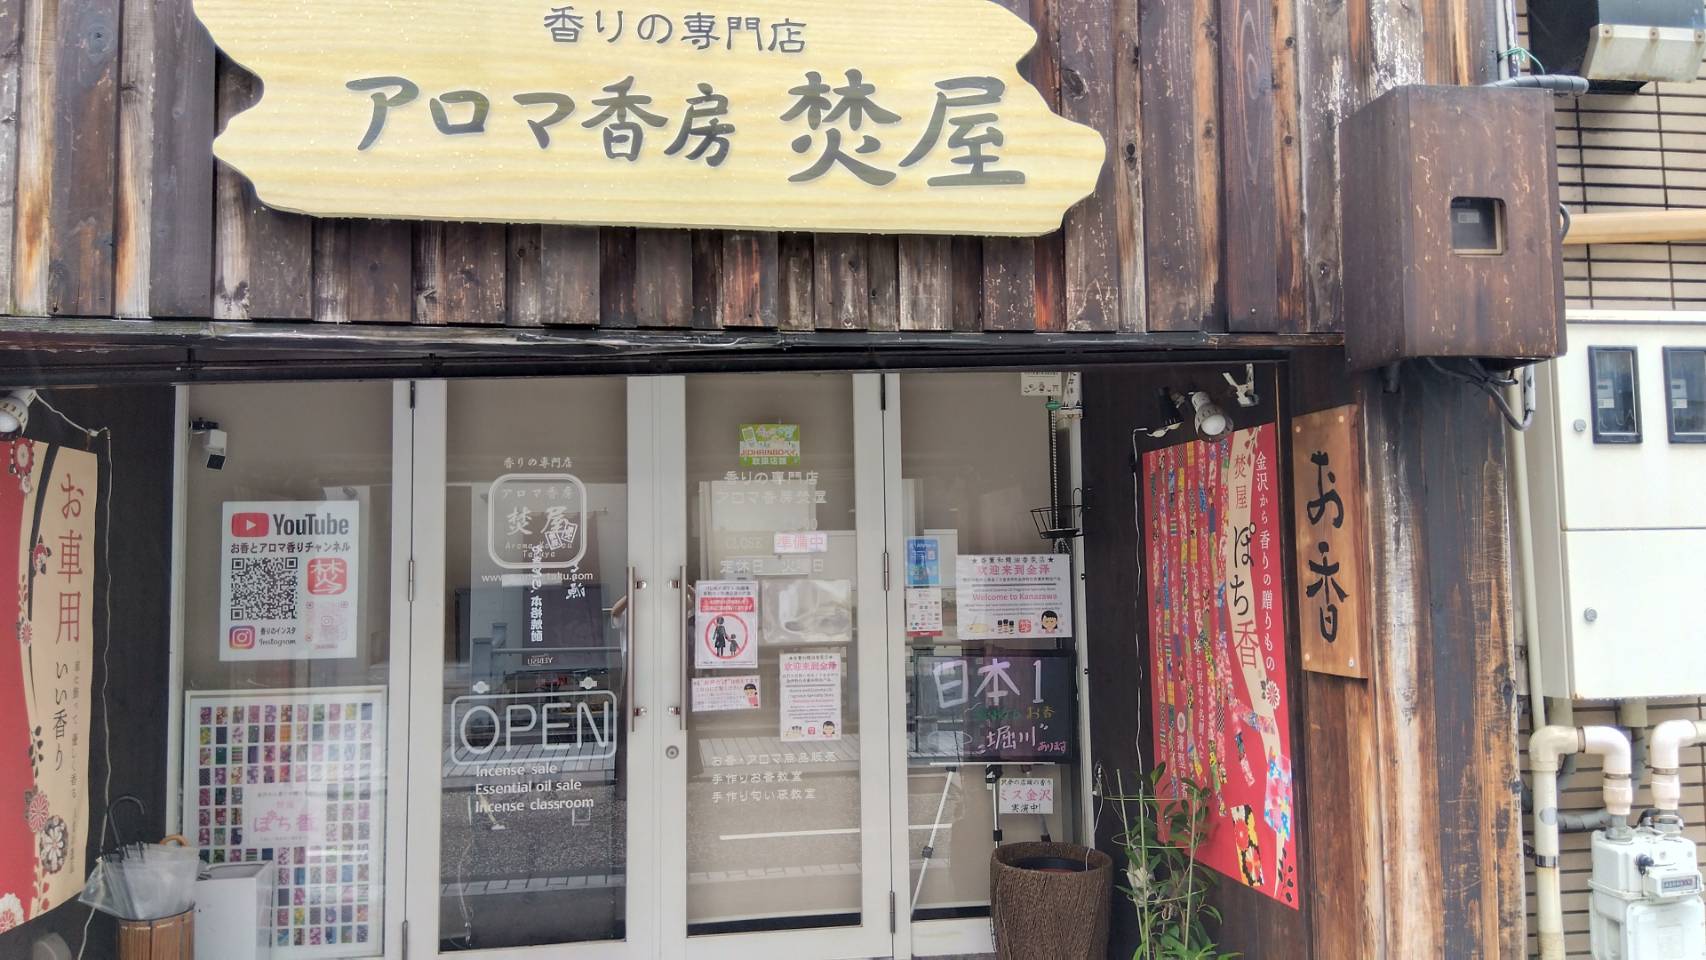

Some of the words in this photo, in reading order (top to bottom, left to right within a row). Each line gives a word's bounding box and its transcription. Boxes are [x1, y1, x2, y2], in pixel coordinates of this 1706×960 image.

[543, 6, 807, 53] 香りの専門店
[345, 76, 737, 167] アロマ香房
[779, 69, 1026, 187] 焚屋
[504, 457, 573, 469] 香りの専門店
[723, 470, 819, 484] 香りの専門店
[1233, 454, 1249, 509] 焚屋
[273, 513, 349, 536] YouTube
[506, 505, 569, 535] 焚屋
[231, 541, 350, 554] お香とアロマ香りチャンネル
[776, 535, 824, 550] 準備中
[1306, 451, 1350, 643] お香
[56, 473, 84, 645] お車用
[1256, 451, 1275, 671] 金沢から香りの贈りもの
[1230, 521, 1260, 670] ぽち香
[52, 661, 68, 771] いい香り
[460, 701, 609, 754] OPEN
[476, 765, 525, 777] Incense
[531, 763, 558, 775] sale
[712, 771, 802, 785] 手作りお香教室
[475, 781, 532, 795] Essential
[536, 780, 552, 792] oil
[556, 779, 582, 791] sale
[1000, 788, 1052, 801] ミス金沢
[475, 800, 524, 812] Incense
[530, 797, 594, 810] classroom
